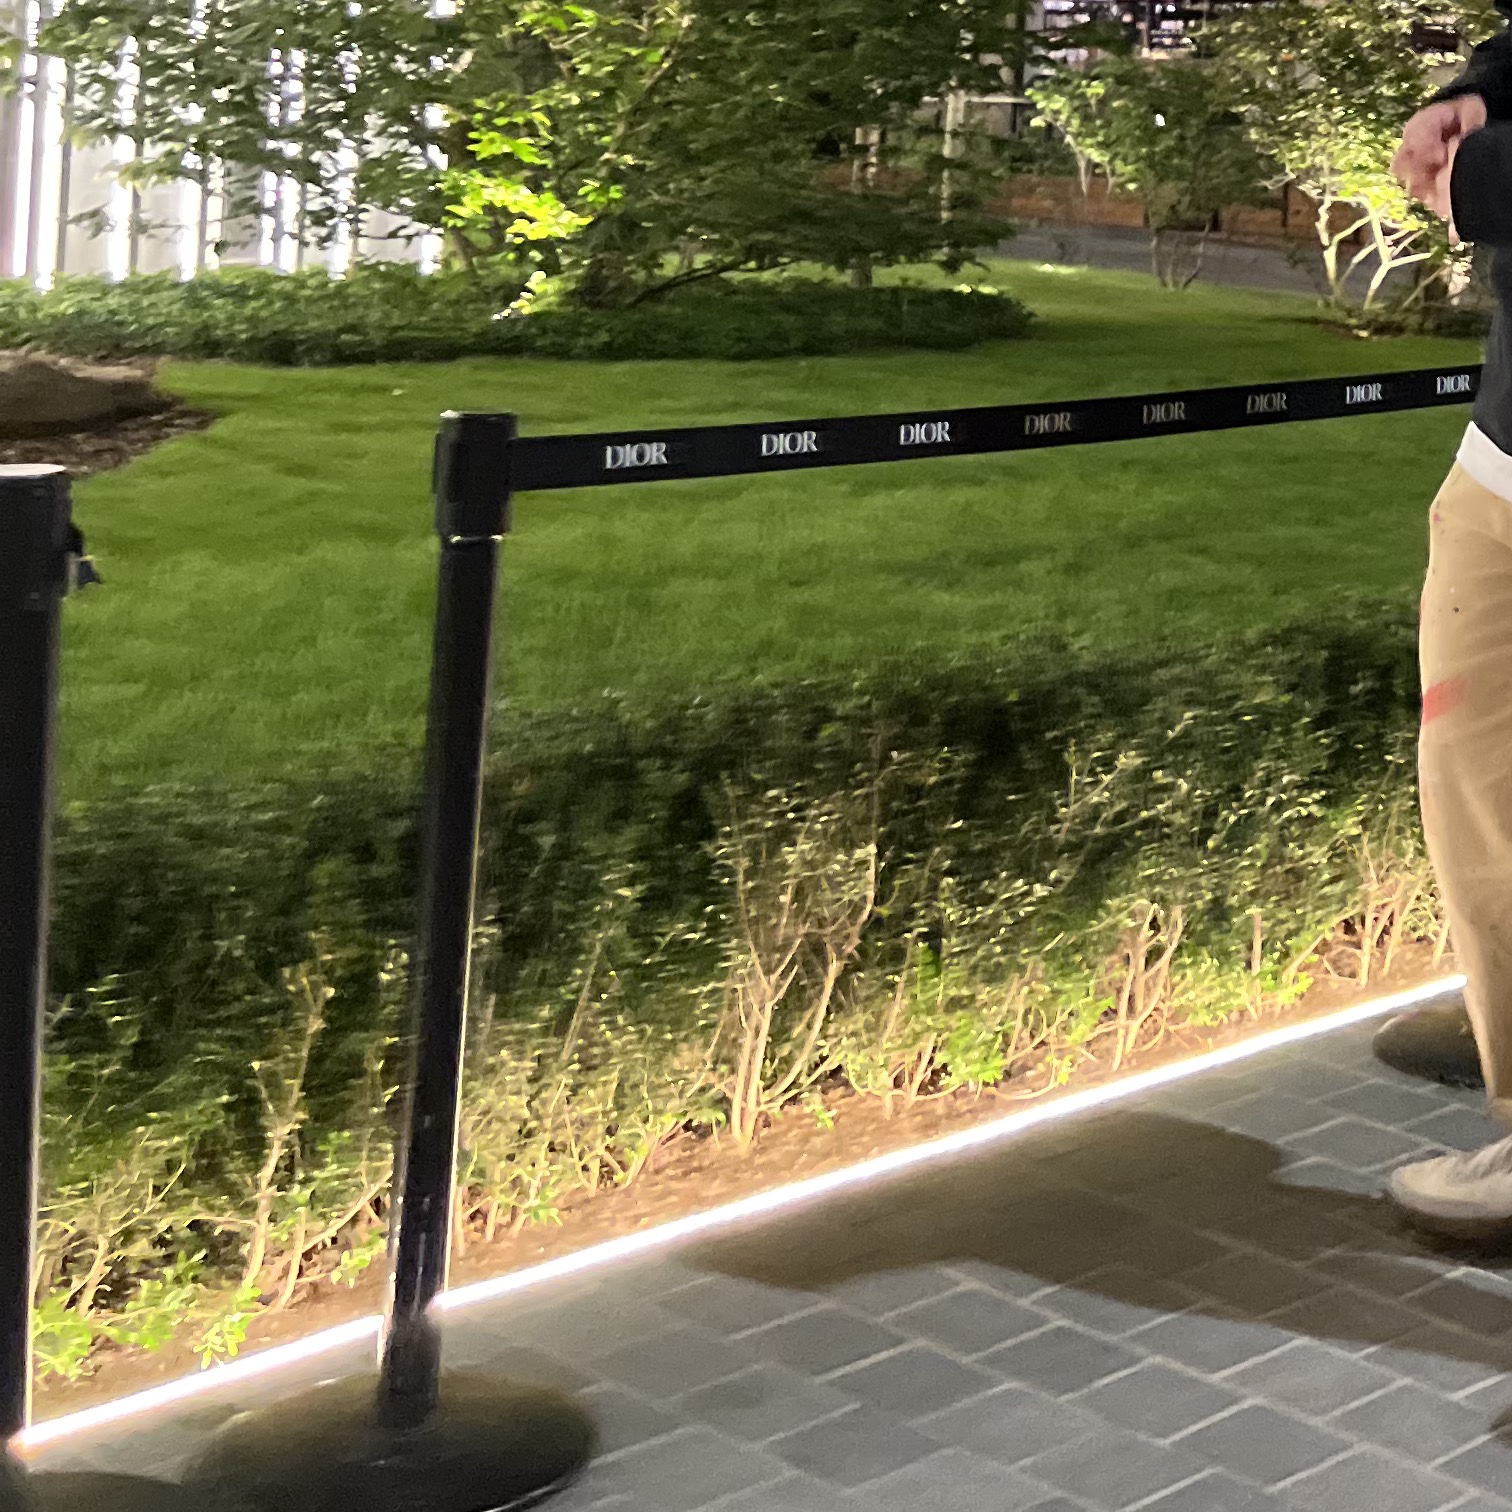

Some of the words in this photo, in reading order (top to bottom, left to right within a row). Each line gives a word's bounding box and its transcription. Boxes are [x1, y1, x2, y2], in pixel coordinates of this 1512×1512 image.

[605, 441, 668, 470] DIOR
[761, 430, 818, 457] DIOR
[899, 421, 951, 446] DIOR
[1024, 411, 1072, 435] DIOR
[1142, 401, 1186, 425] DIOR
[1246, 391, 1288, 414] DIOR
[1345, 382, 1383, 405] DIOR
[1436, 374, 1471, 395] DIOR
